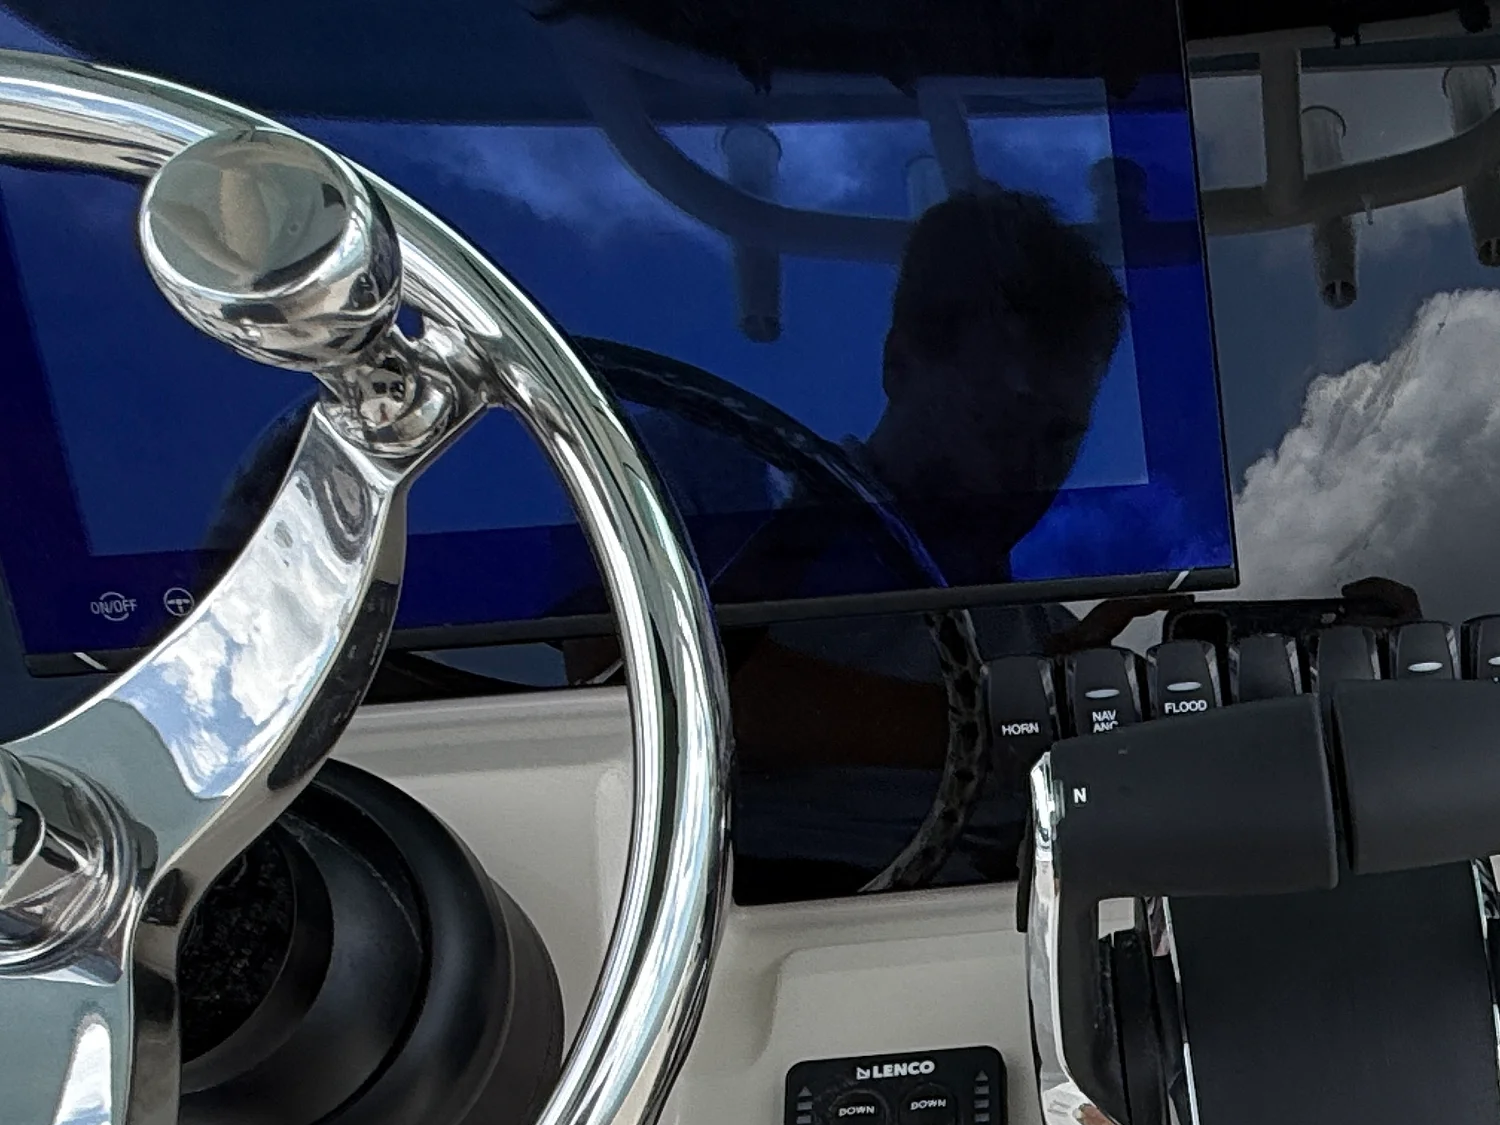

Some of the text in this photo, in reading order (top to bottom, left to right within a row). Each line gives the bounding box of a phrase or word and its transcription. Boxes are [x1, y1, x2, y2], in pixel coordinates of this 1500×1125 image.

[90, 598, 137, 615] ON/OFF
[1164, 700, 1208, 714] FLOOD
[1092, 709, 1117, 722] NAV
[1001, 722, 1040, 736] HORN
[1073, 787, 1088, 804] N
[872, 1060, 936, 1079] LENCO
[838, 1105, 875, 1117] DOWN
[910, 1098, 946, 1110] DOWN
